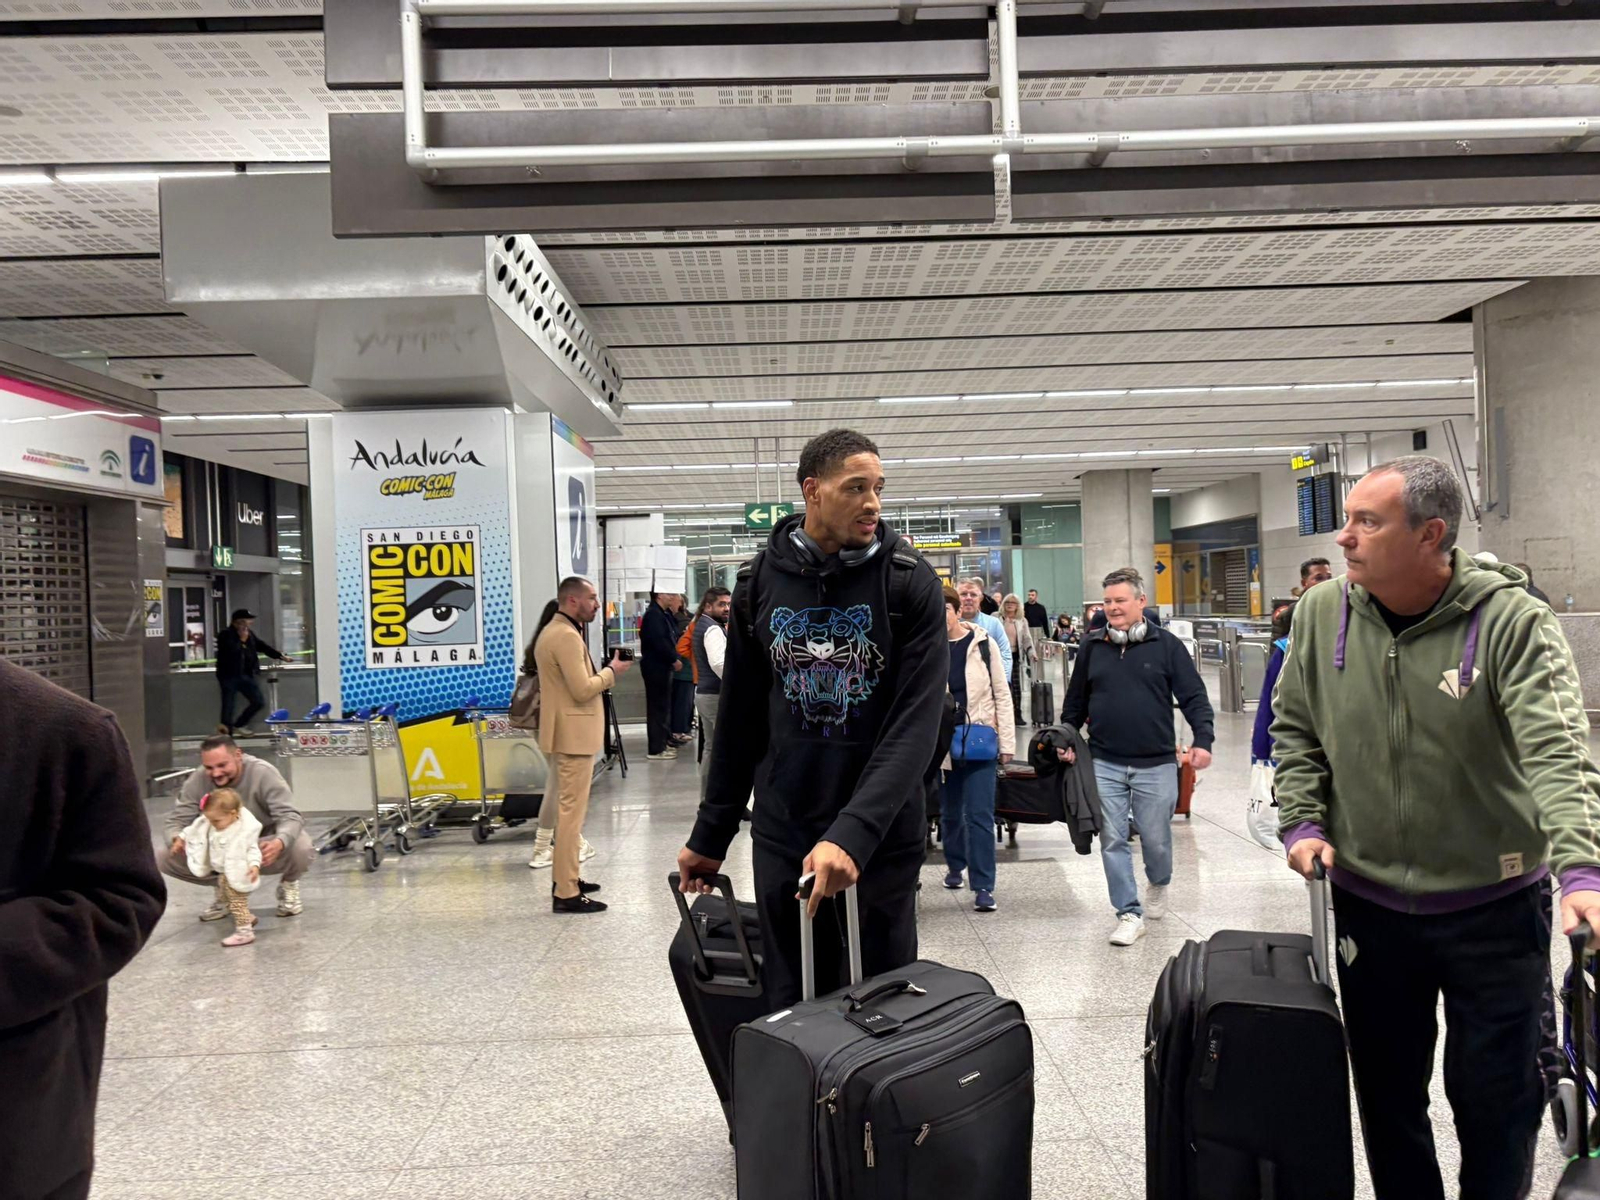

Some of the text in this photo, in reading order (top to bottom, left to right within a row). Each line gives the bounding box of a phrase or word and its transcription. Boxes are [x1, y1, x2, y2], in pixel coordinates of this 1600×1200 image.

[349, 436, 486, 471] Andalucía
[237, 501, 263, 526] Uber
[367, 530, 474, 543] SAN DIEGO
[407, 542, 473, 577] CON
[370, 545, 407, 646] COMIC
[373, 647, 477, 664] MÁLAGA
